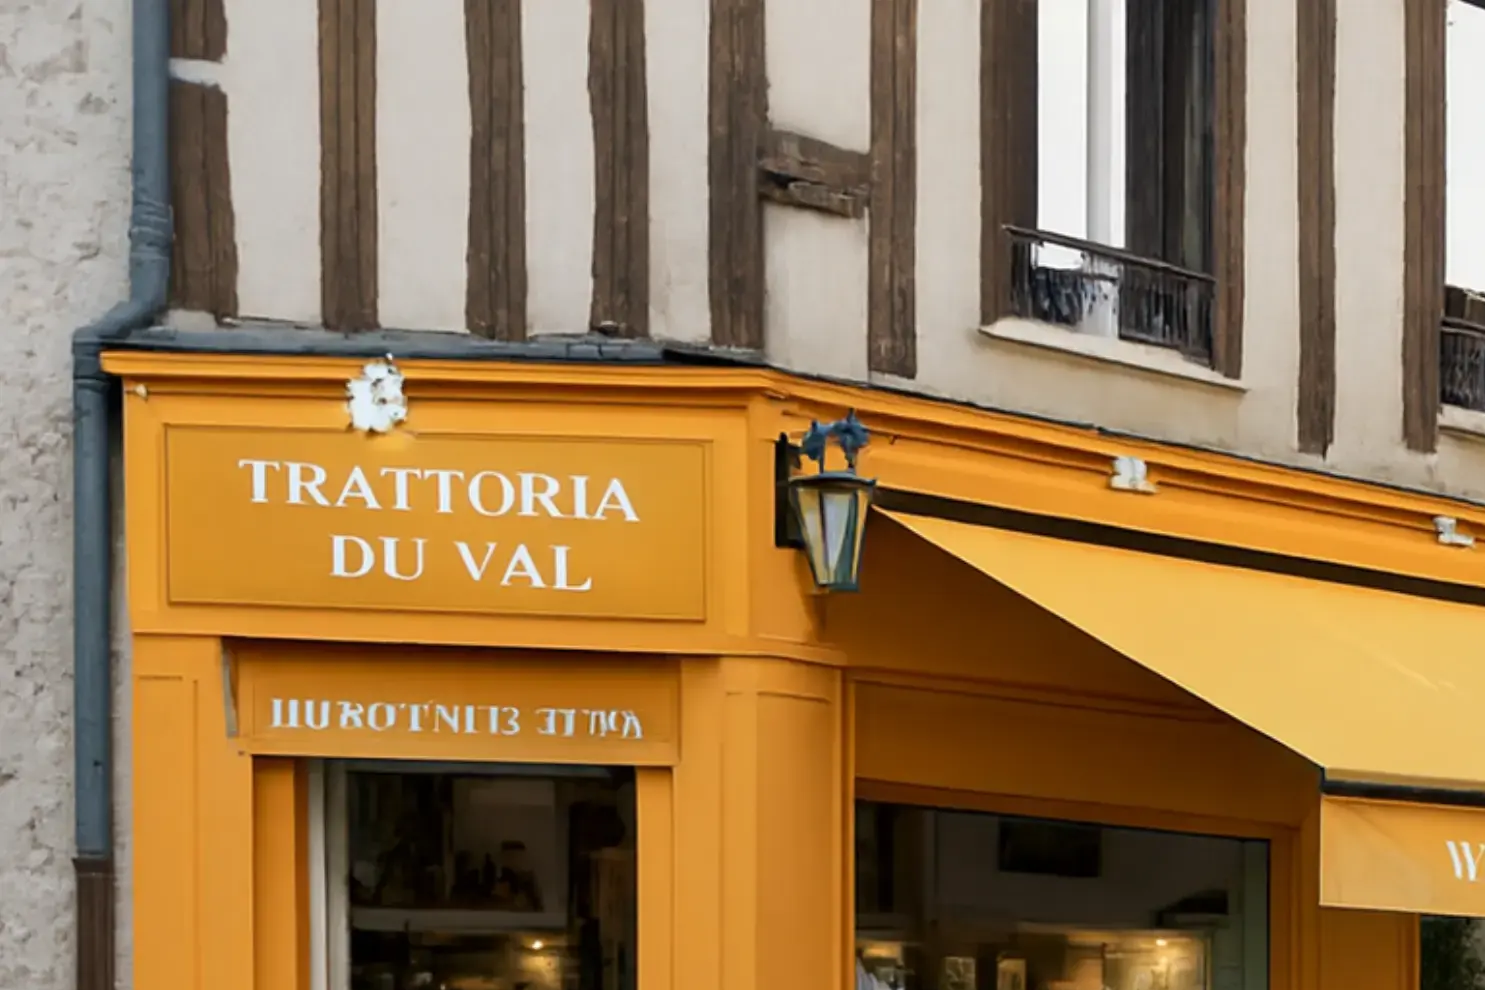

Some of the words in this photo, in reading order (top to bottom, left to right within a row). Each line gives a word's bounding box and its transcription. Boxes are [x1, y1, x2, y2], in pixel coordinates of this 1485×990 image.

[238, 459, 640, 523] TRATTORIA
[330, 534, 425, 581] DU
[454, 540, 593, 592] VAL
